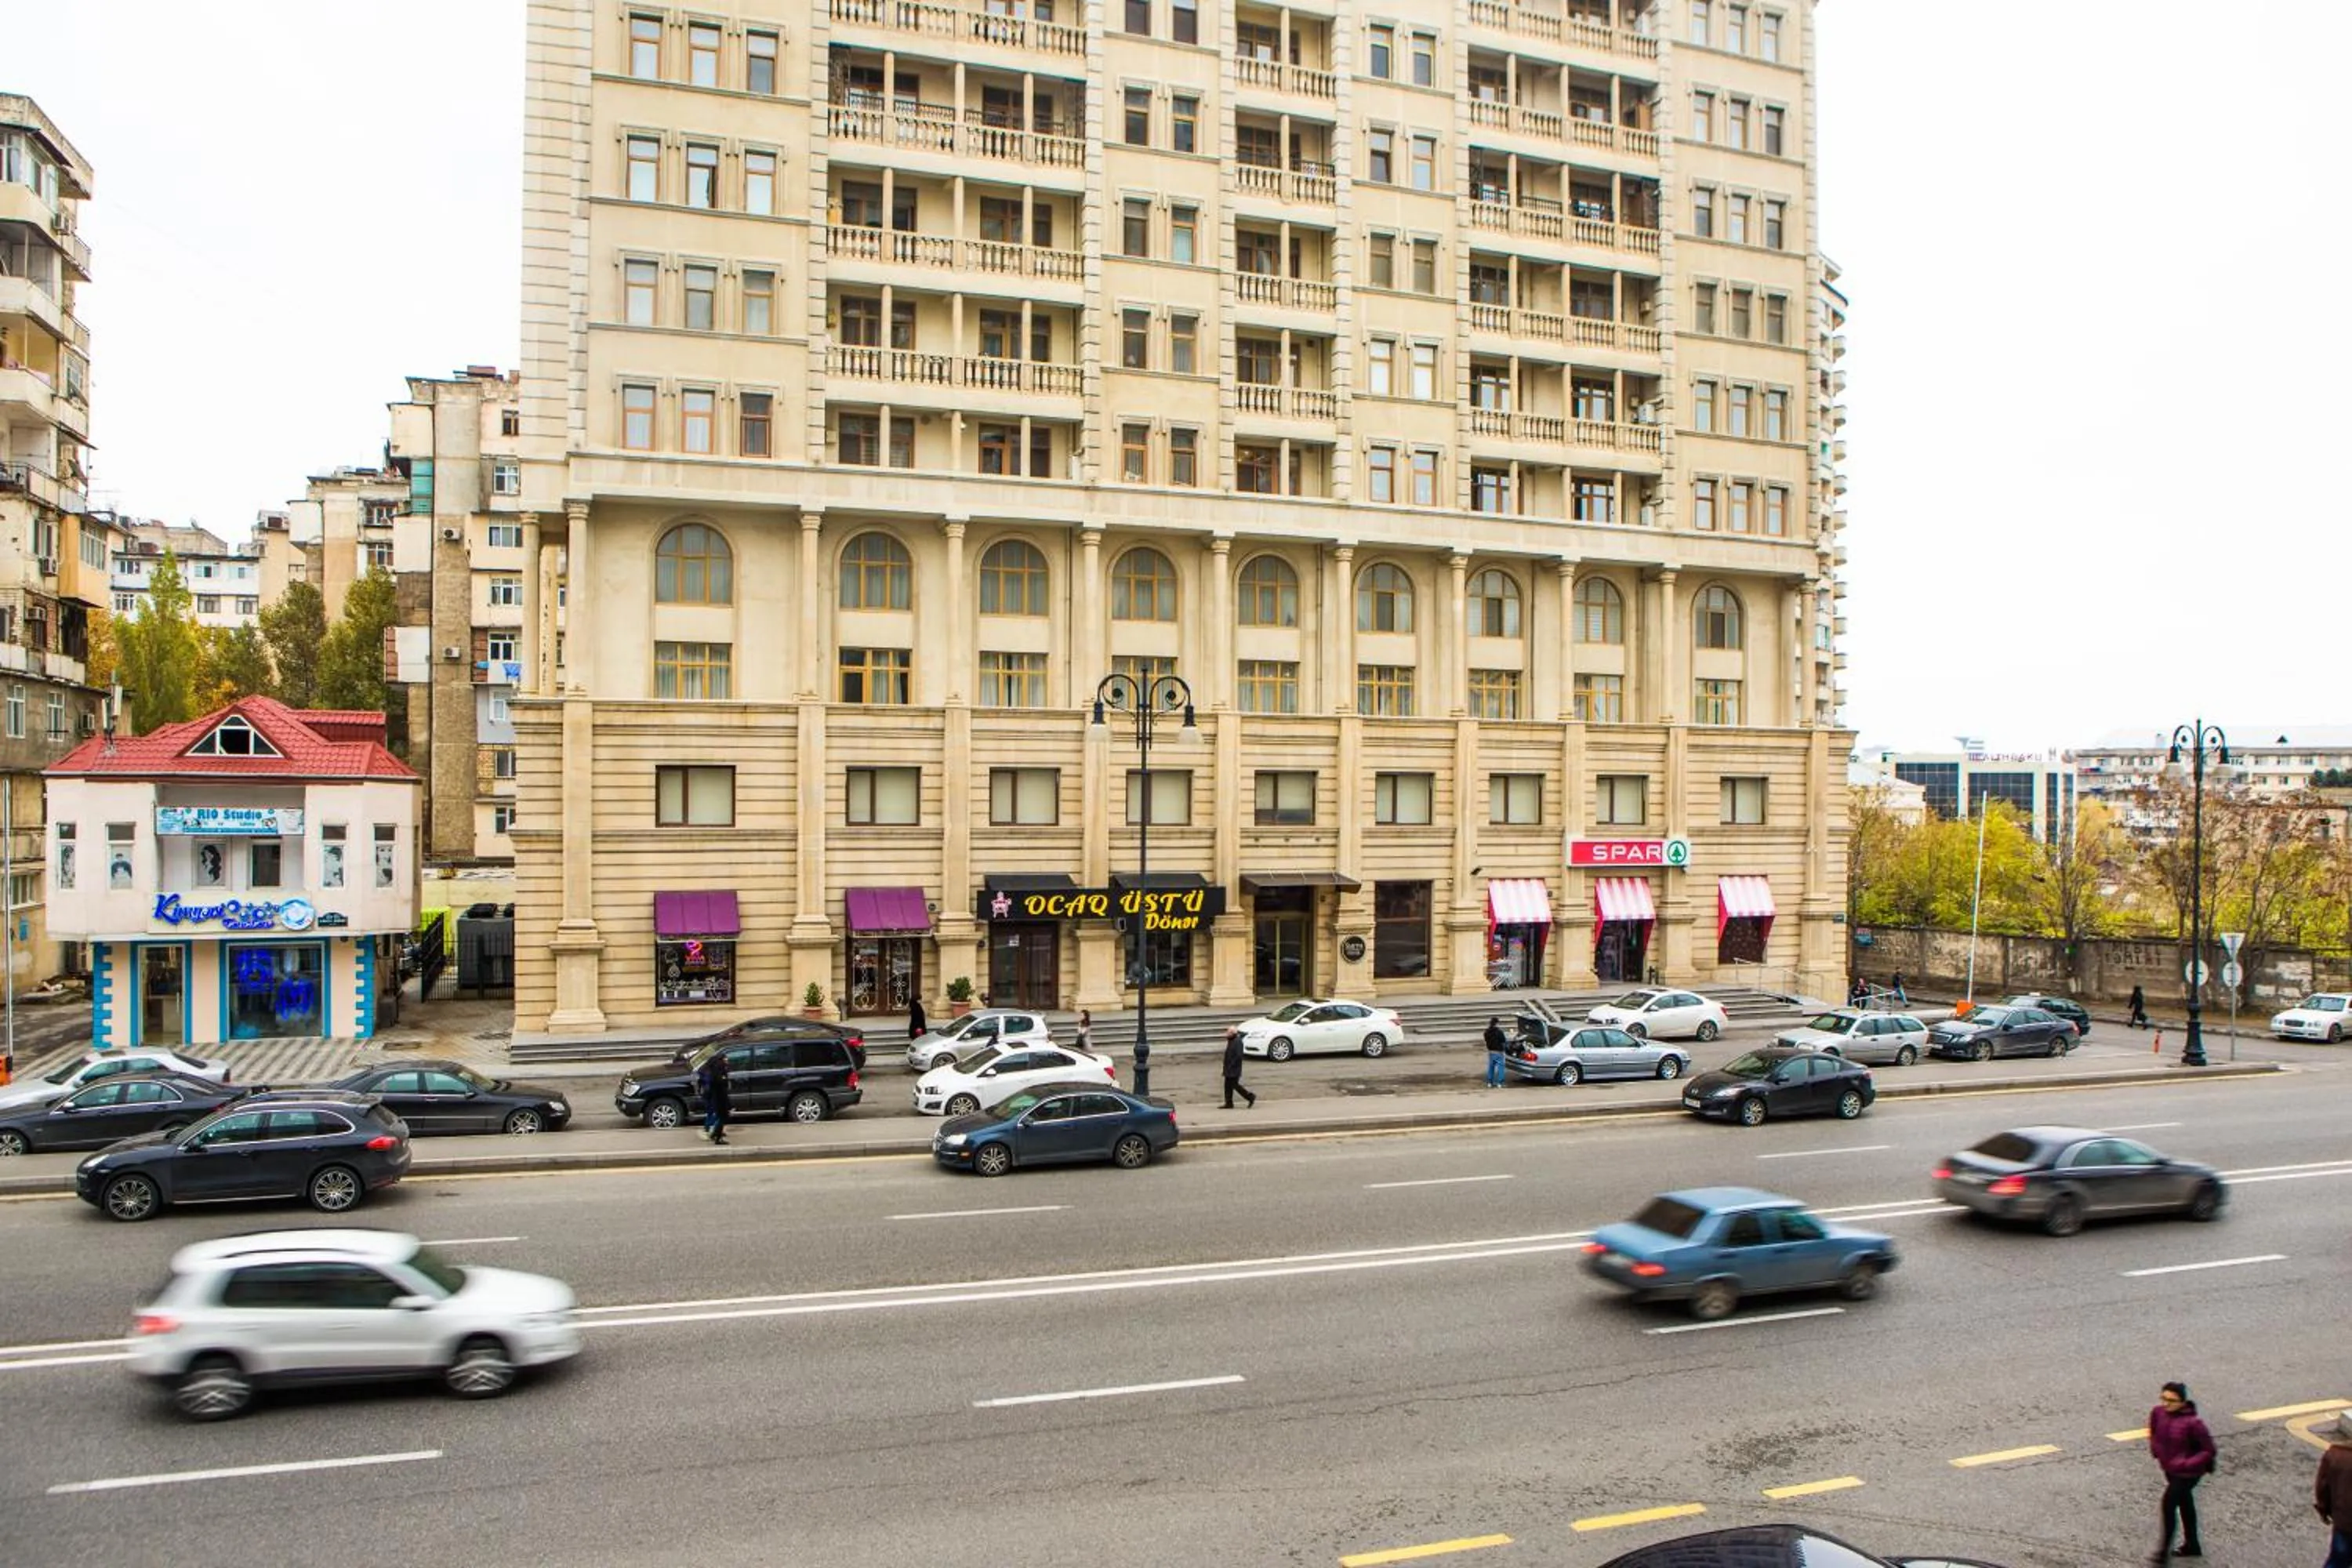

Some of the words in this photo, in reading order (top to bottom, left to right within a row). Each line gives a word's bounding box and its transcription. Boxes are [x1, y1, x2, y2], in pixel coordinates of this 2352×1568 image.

[198, 809, 218, 819] RIO
[223, 809, 263, 820] Studio
[1592, 845, 1661, 860] SPAR
[1025, 895, 1108, 916] OCAQ
[1120, 890, 1204, 913] ÜSTÜ
